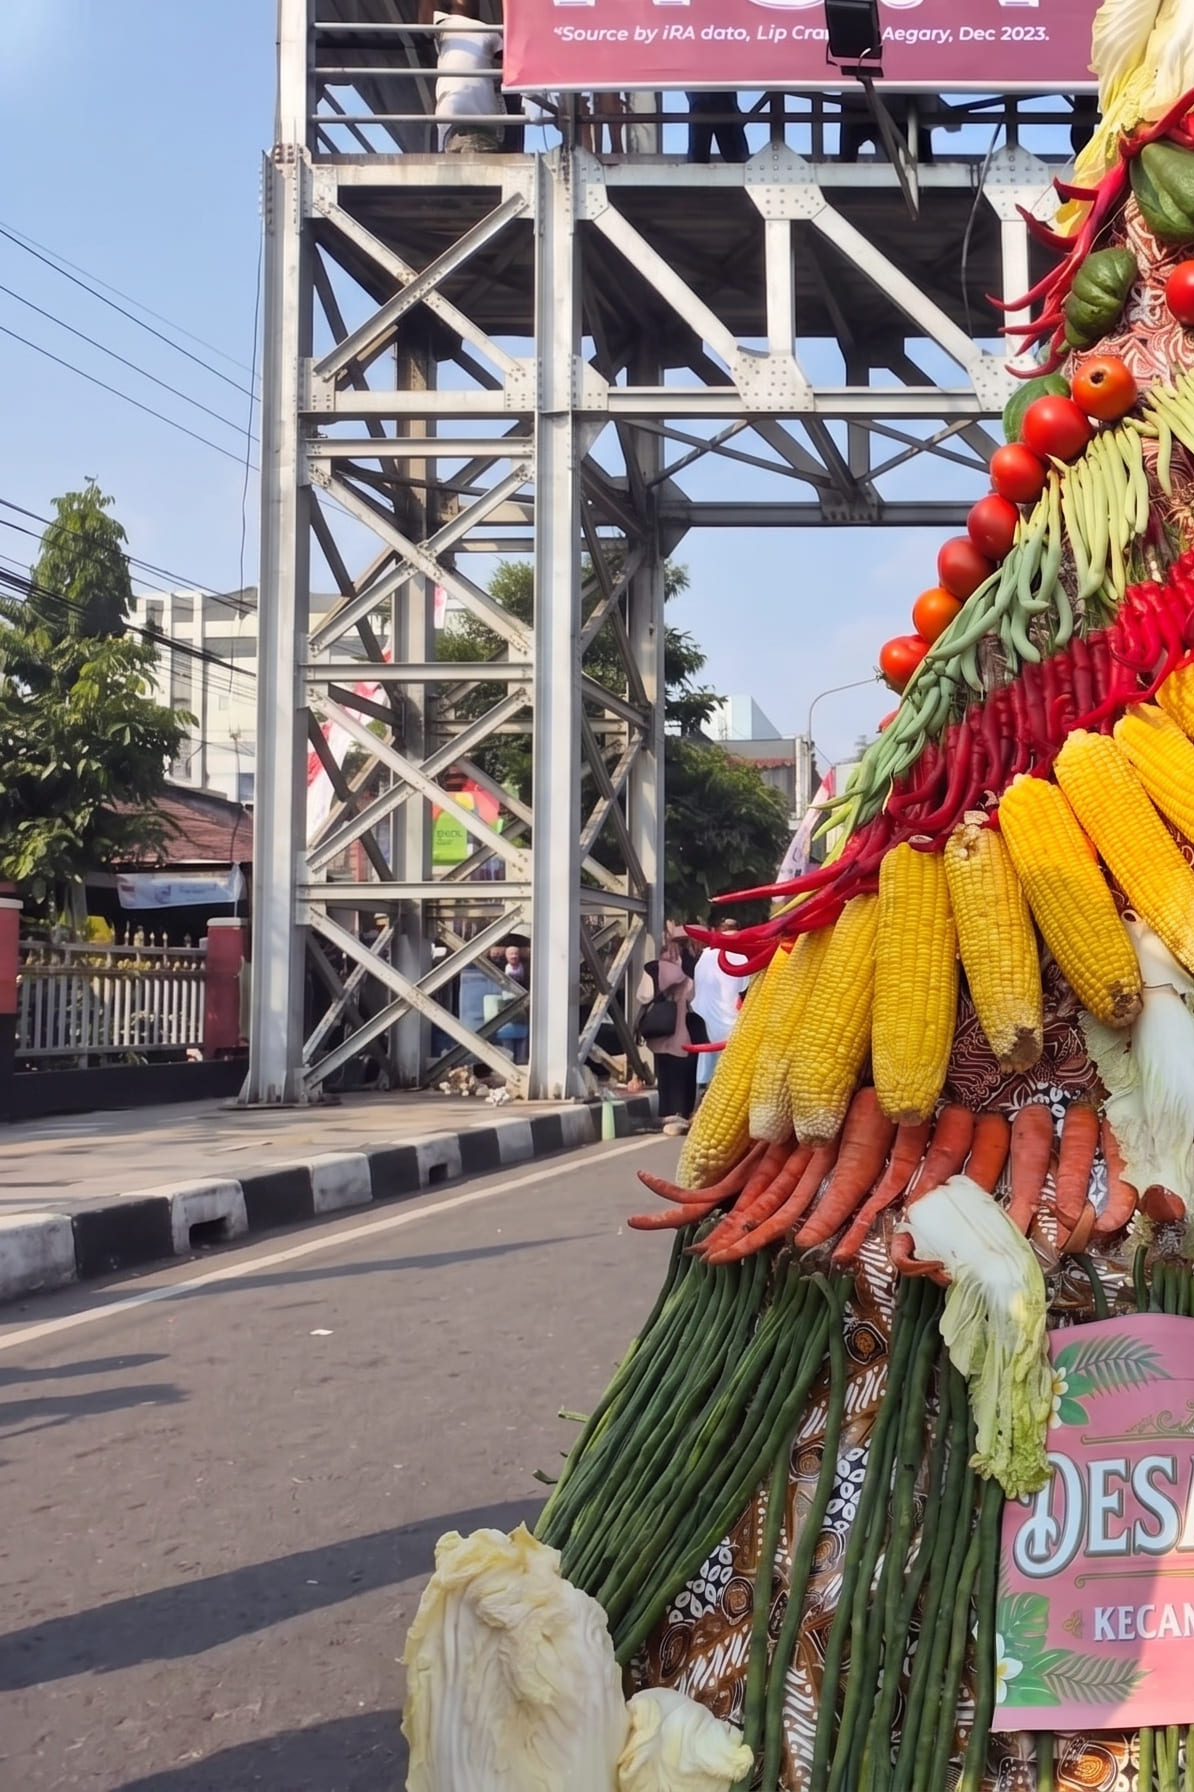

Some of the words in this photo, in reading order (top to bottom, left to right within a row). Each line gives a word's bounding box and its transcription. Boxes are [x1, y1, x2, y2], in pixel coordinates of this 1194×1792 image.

[634, 25, 659, 44] by
[662, 24, 696, 40] iRA
[700, 24, 751, 42] dato,
[757, 24, 788, 43] Lip
[959, 26, 996, 41] Dec
[1000, 26, 1050, 41] 2023.
